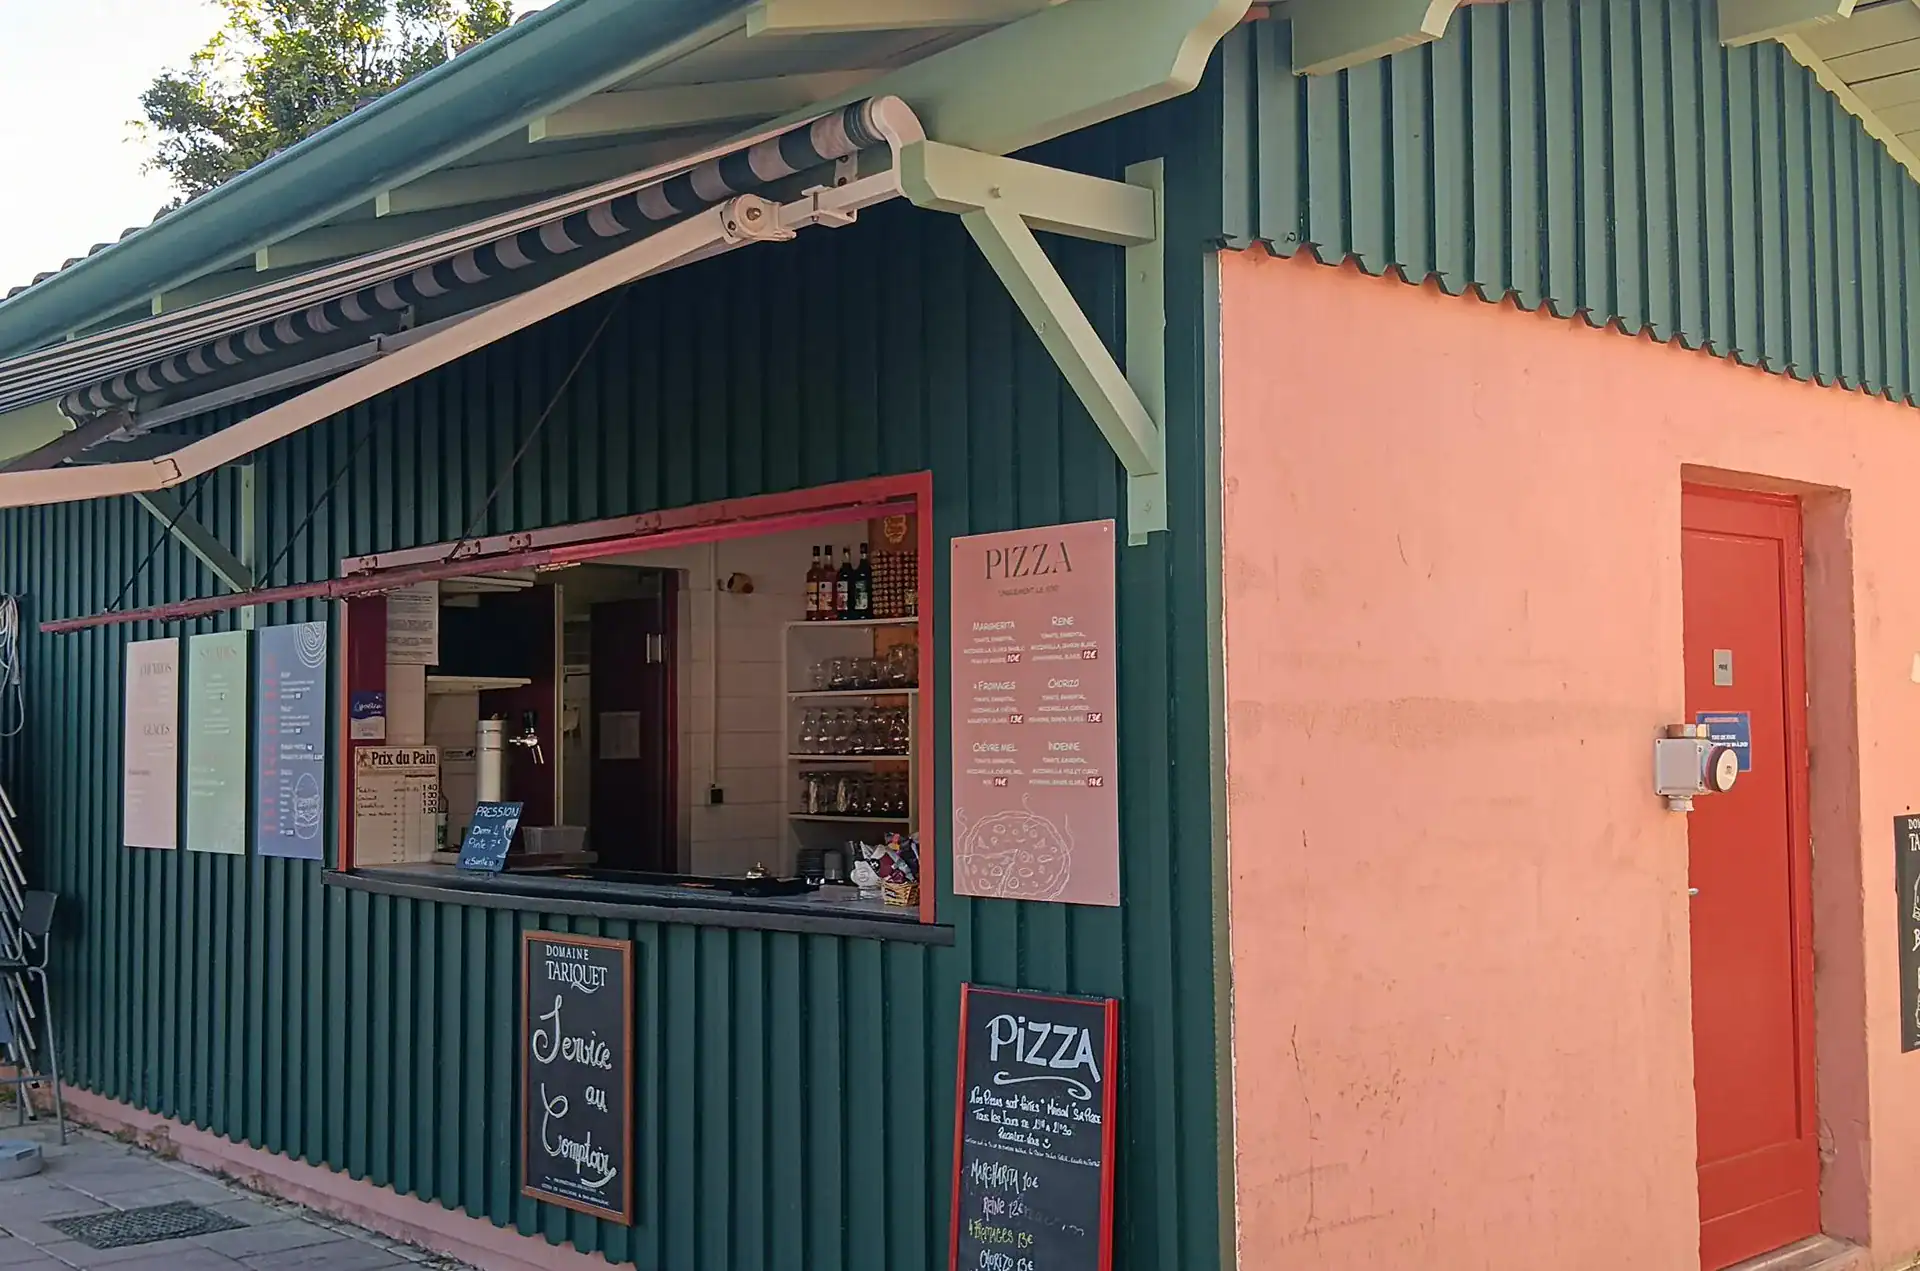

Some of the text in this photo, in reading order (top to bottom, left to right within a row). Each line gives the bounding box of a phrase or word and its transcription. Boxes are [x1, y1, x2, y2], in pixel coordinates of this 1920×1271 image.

[985, 541, 1073, 580] PIZZA
[1007, 654, 1021, 663] 10€
[1082, 650, 1096, 660] 12€
[978, 680, 1016, 691] FROMAGES
[1087, 713, 1102, 723] 13€
[371, 751, 394, 766] Prix
[396, 750, 410, 765] du
[413, 750, 436, 765] Pain
[475, 805, 520, 818] PRESSION
[545, 944, 590, 961] DOMAINE
[545, 960, 608, 994] TARIQUET
[532, 994, 612, 1070] Service
[585, 1085, 608, 1113] au
[541, 1082, 617, 1188] Comptoir
[1022, 1171, 1040, 1192] 10€
